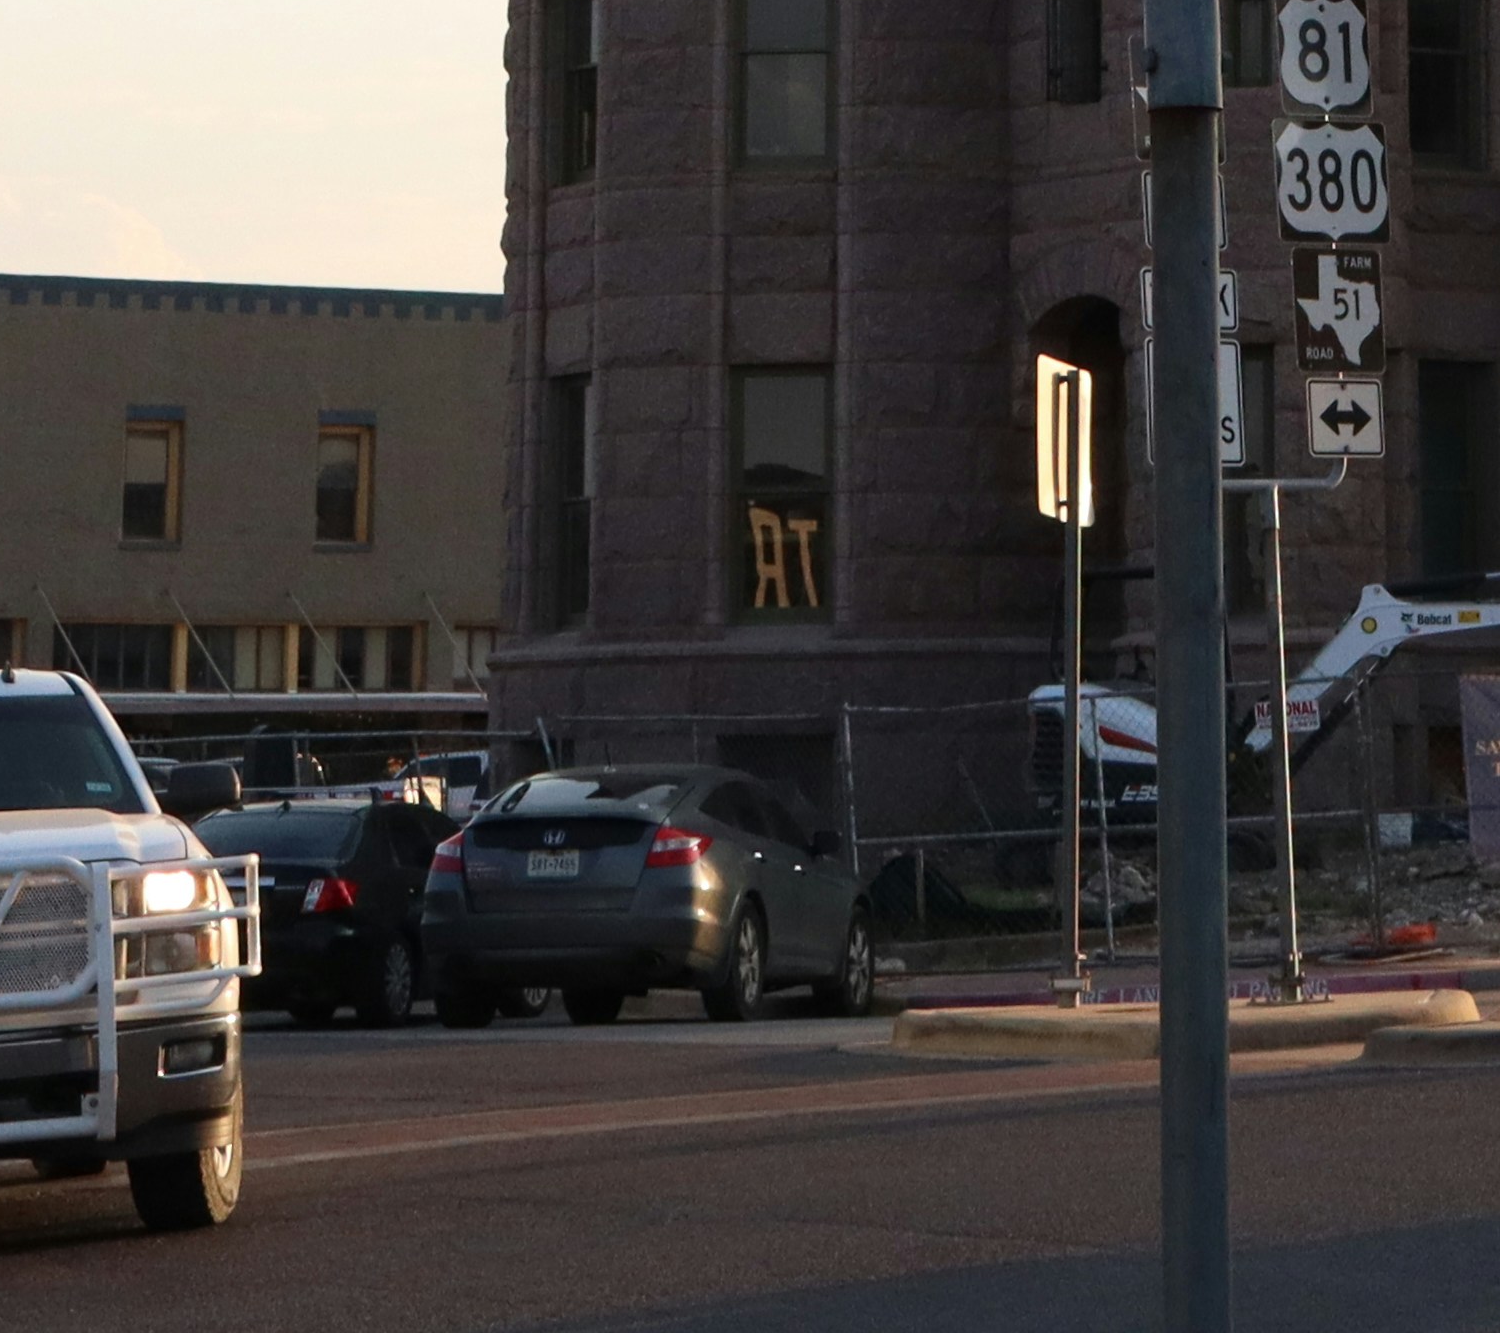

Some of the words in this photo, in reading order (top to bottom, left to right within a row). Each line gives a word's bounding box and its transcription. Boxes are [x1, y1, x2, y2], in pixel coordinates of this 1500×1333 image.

[1298, 18, 1352, 84] 81
[1287, 147, 1377, 213] 380
[1343, 256, 1372, 270] FARM
[1333, 288, 1360, 321] 51
[1306, 346, 1334, 360] ROAD
[1417, 614, 1452, 625] Bobcat
